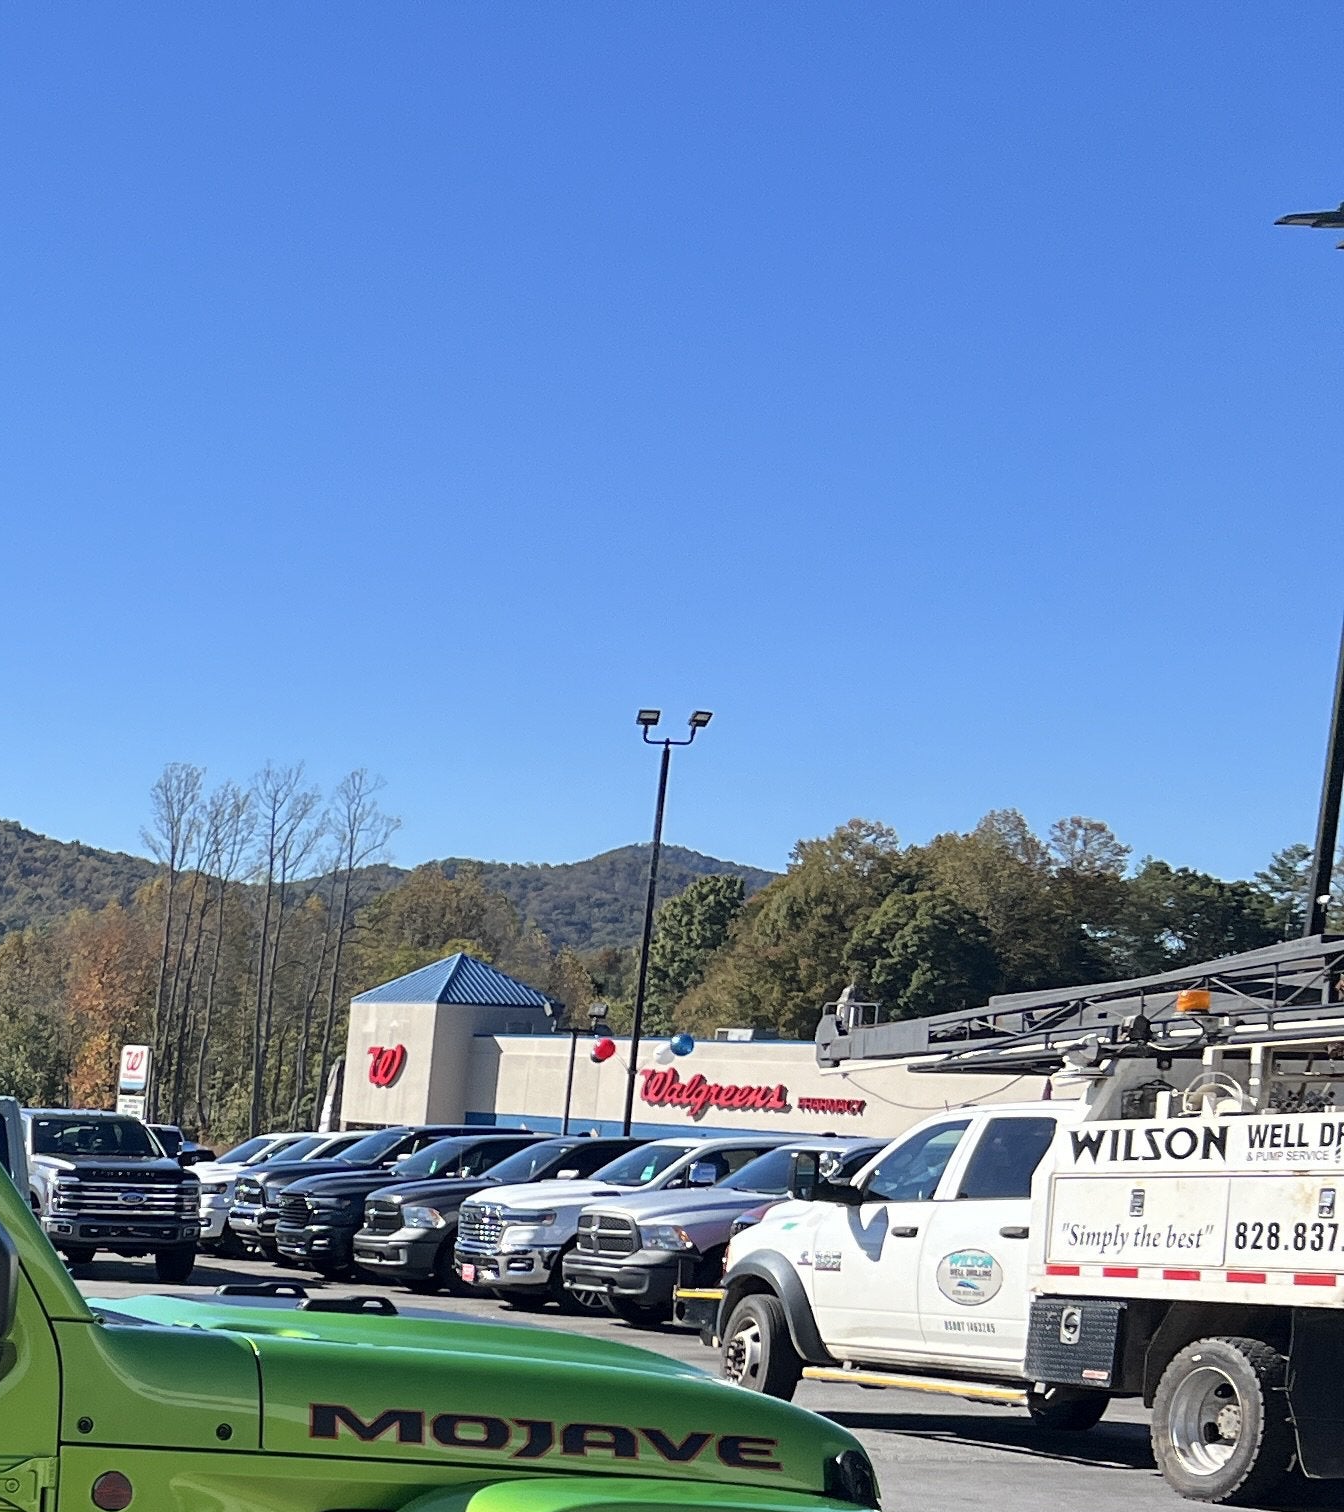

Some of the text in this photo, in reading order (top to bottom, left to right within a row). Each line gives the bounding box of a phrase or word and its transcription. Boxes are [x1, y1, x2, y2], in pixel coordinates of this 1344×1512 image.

[367, 1044, 406, 1087] W
[640, 1066, 792, 1121] Walgreens
[798, 1096, 866, 1116] PHARMACY
[1070, 1125, 1230, 1164] WILSON
[1248, 1122, 1310, 1149] WELL
[1256, 1150, 1284, 1161] PUMP
[1286, 1149, 1330, 1161] SERVICE
[1062, 1222, 1214, 1255] "Simply the best"
[310, 1403, 783, 1470] MOJAVE
